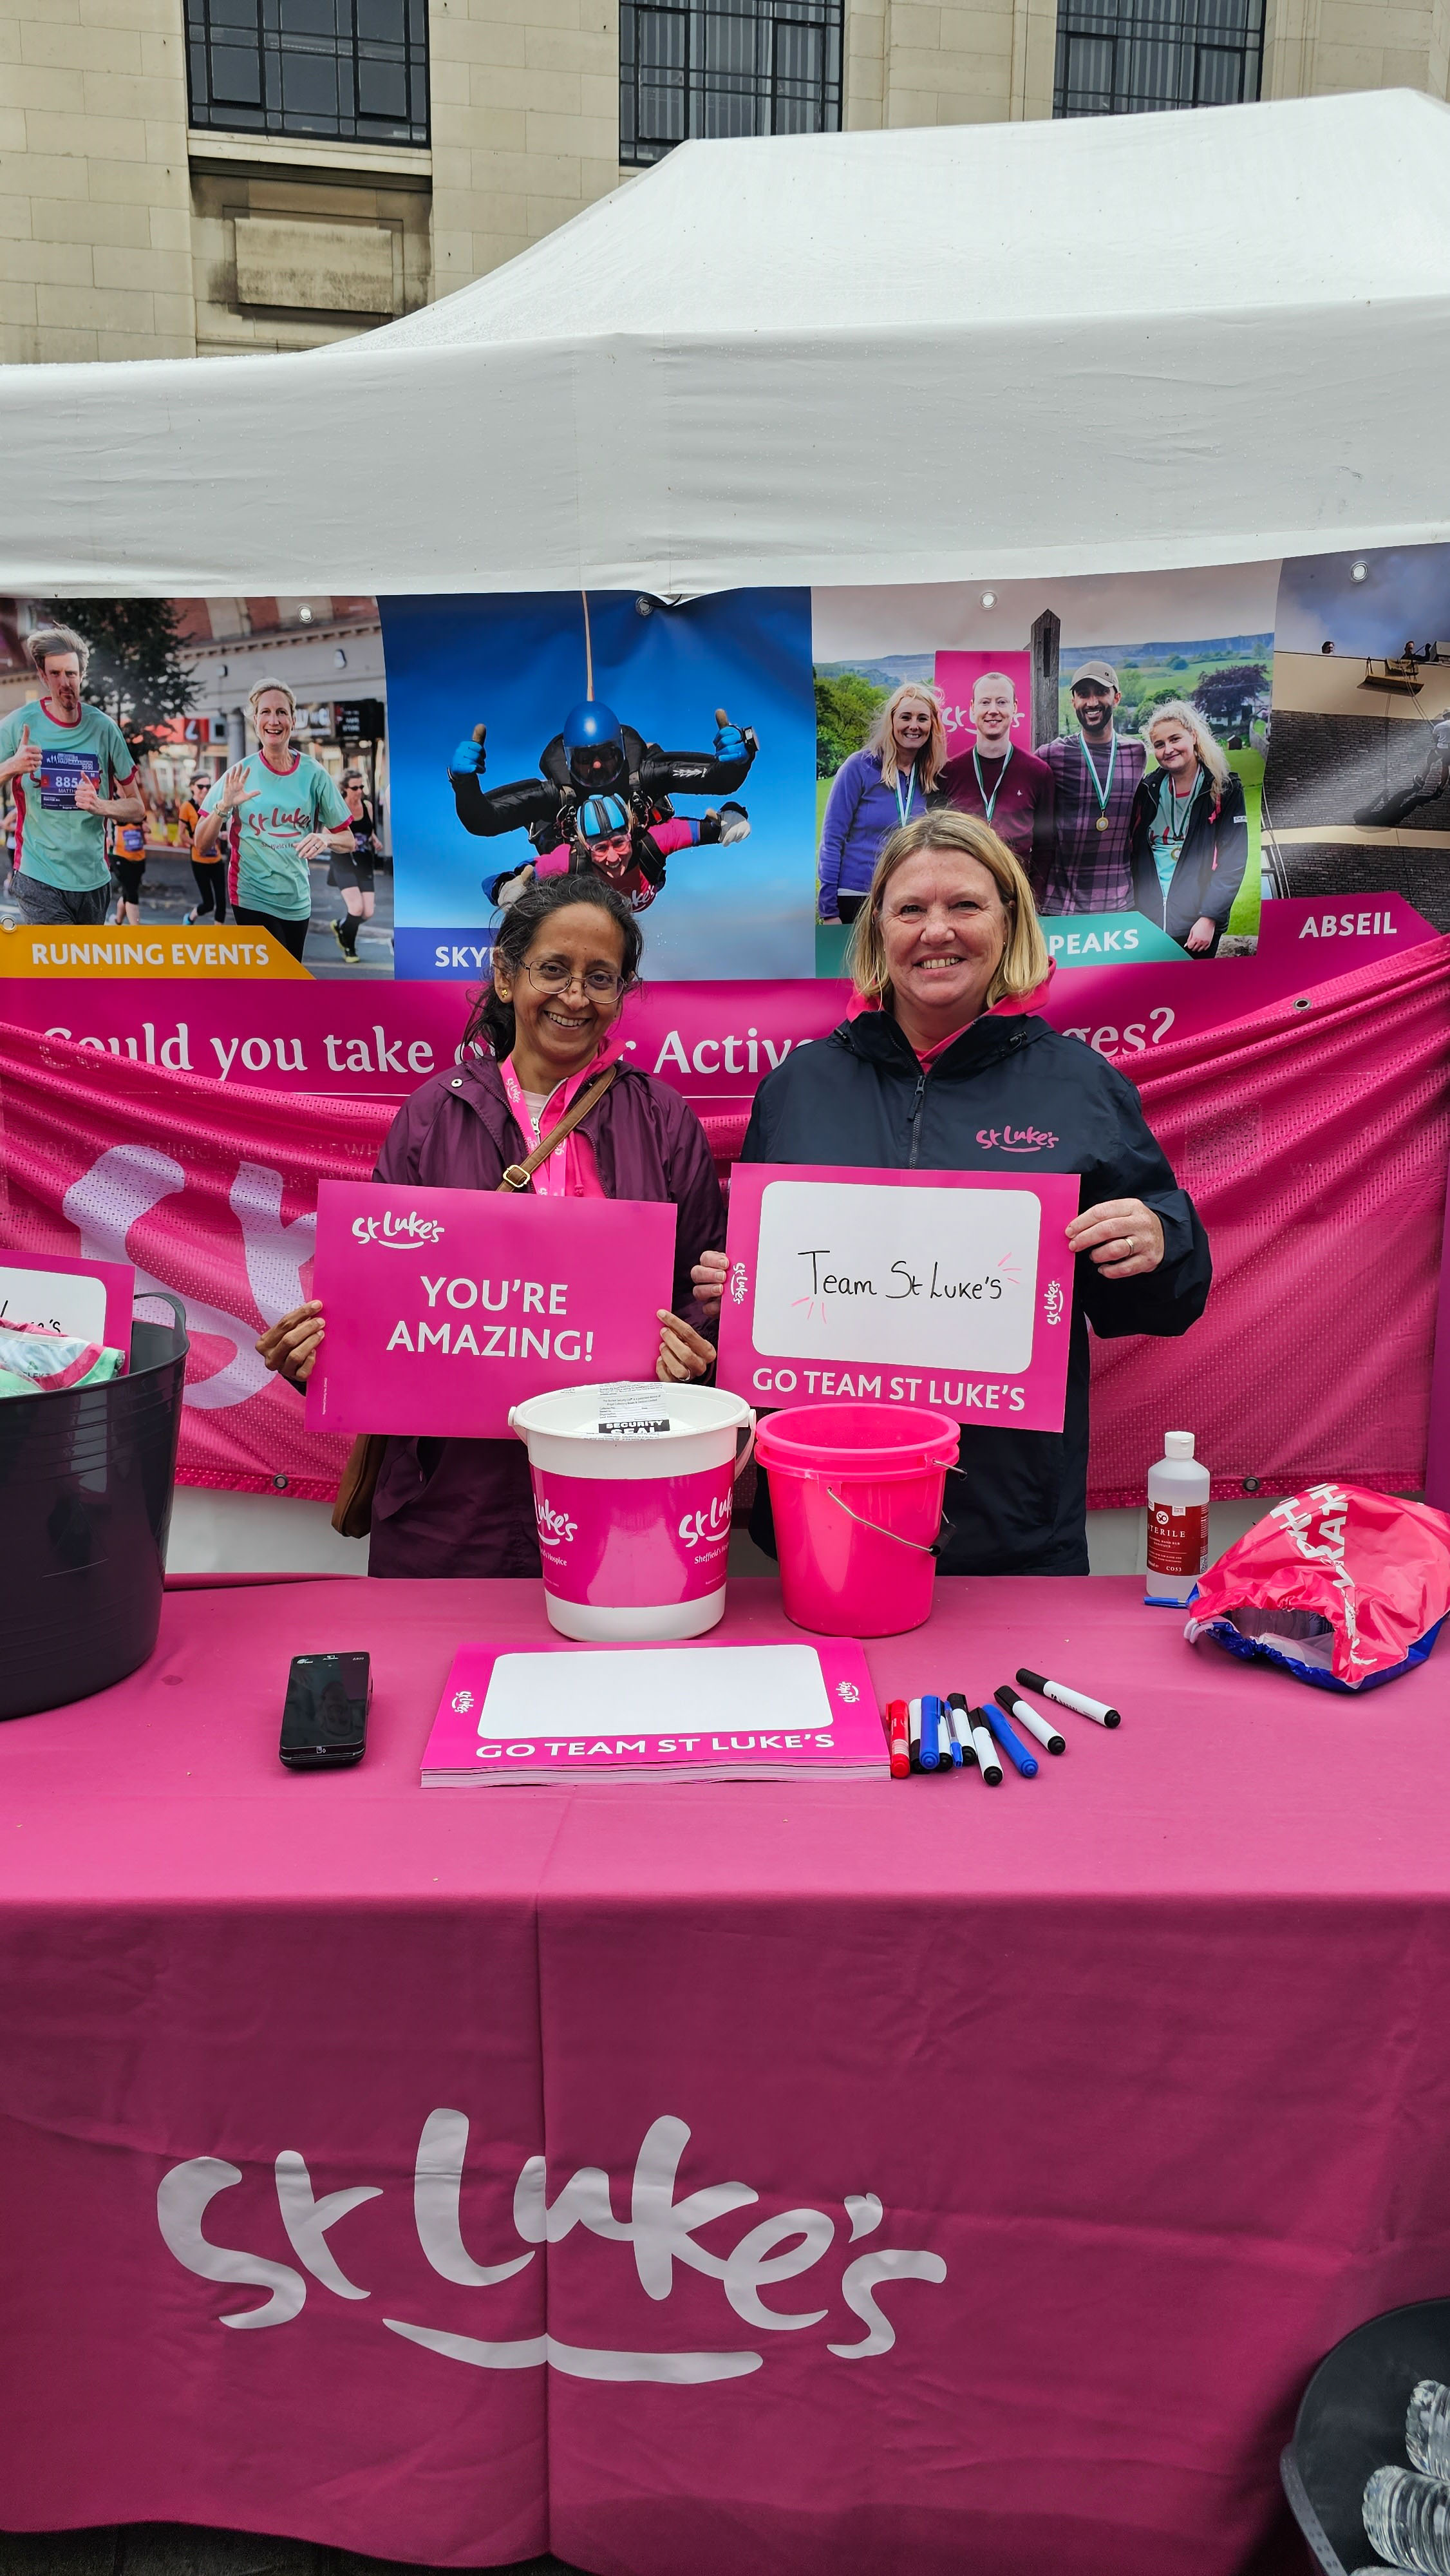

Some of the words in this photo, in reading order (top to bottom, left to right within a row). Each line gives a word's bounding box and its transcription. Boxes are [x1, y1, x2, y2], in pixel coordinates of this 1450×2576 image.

[1299, 912, 1397, 939] ABSEIL
[32, 943, 164, 965] RUNNING
[171, 943, 269, 965] EVENTS
[1050, 929, 1139, 956] PEAKS
[210, 1037, 307, 1082] you
[323, 1025, 435, 1074] take
[653, 1027, 815, 1074] Activ
[975, 1129, 1002, 1149] St
[1003, 1125, 1059, 1148] Luke's
[352, 1217, 381, 1244] St
[383, 1211, 444, 1242] Luke's
[733, 1276, 748, 1305] Luke's
[798, 1250, 878, 1295] Team
[885, 1260, 923, 1299] St
[930, 1261, 1003, 1300] Luke's
[420, 1276, 569, 1315] YOU'RE
[1043, 1280, 1060, 1311] Luke's
[386, 1320, 594, 1362] AMAZING!
[752, 1368, 797, 1392] GO
[803, 1370, 881, 1398] TEAM
[889, 1377, 923, 1402] ST
[928, 1380, 1025, 1411] LUKE'S
[606, 1420, 663, 1429] SECURITY
[679, 1510, 709, 1548] St
[476, 1743, 536, 1759] GO
[544, 1740, 646, 1757] TEAM
[657, 1738, 701, 1752] ST
[711, 1734, 835, 1751] LUKE'S
[156, 2149, 384, 2329] St
[413, 2108, 948, 2360] Luke's
